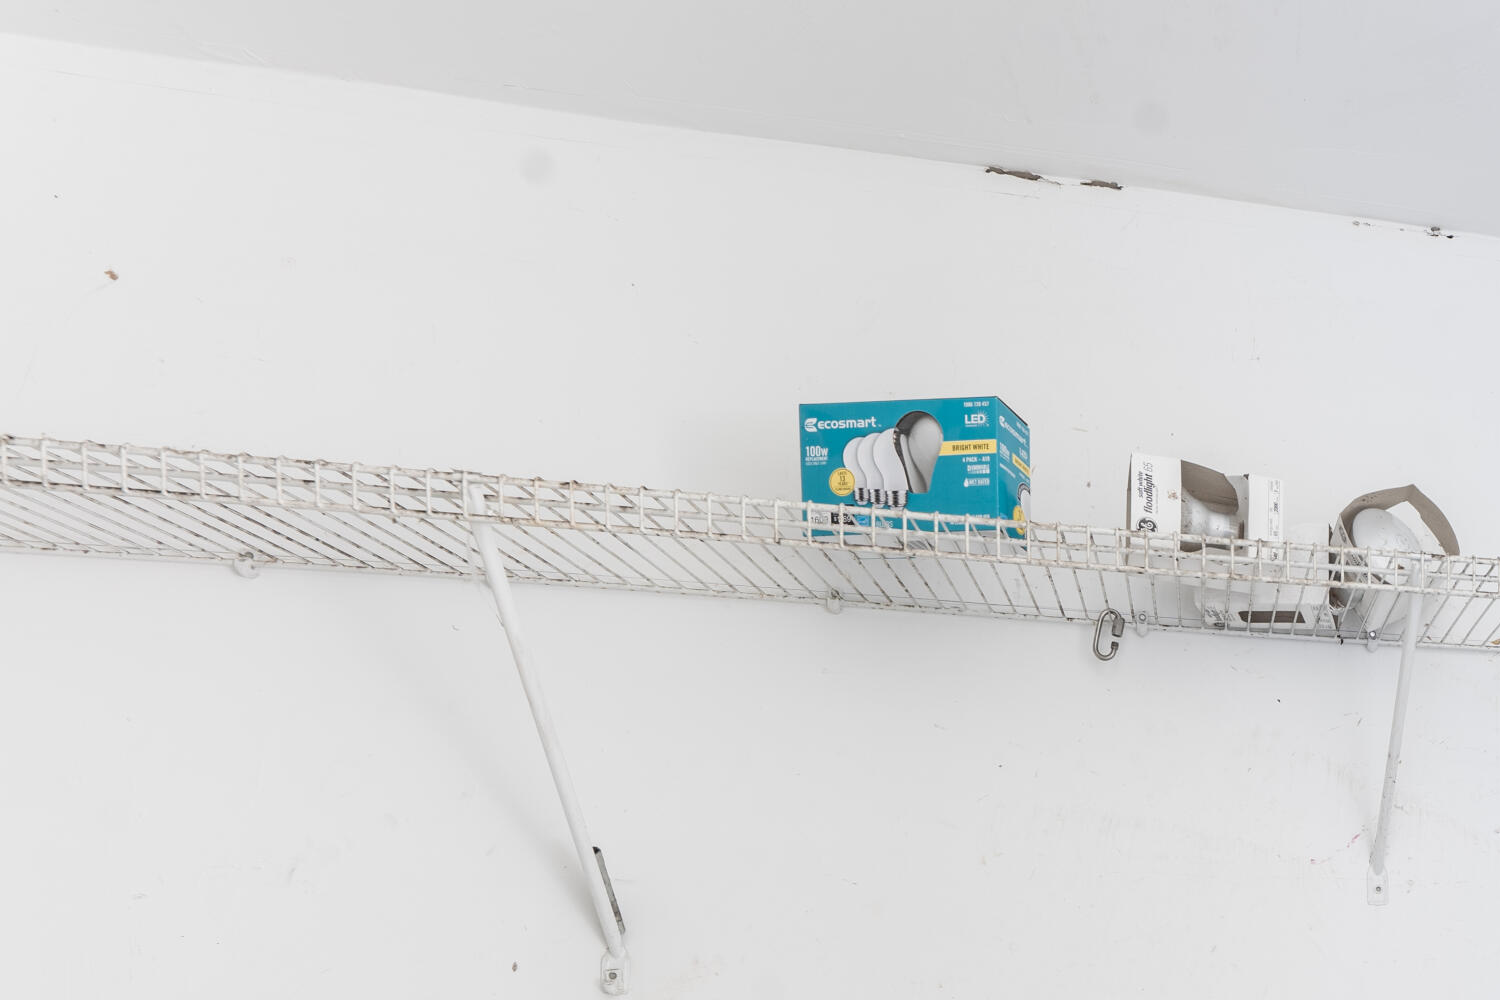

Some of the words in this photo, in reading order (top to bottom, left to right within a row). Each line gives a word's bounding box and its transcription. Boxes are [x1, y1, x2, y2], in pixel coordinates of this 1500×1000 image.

[817, 416, 877, 430] ecosmart
[964, 414, 985, 425] LED
[952, 444, 972, 452] BRIGHT
[973, 443, 989, 451] WHITE
[1143, 473, 1155, 514] floodlight
